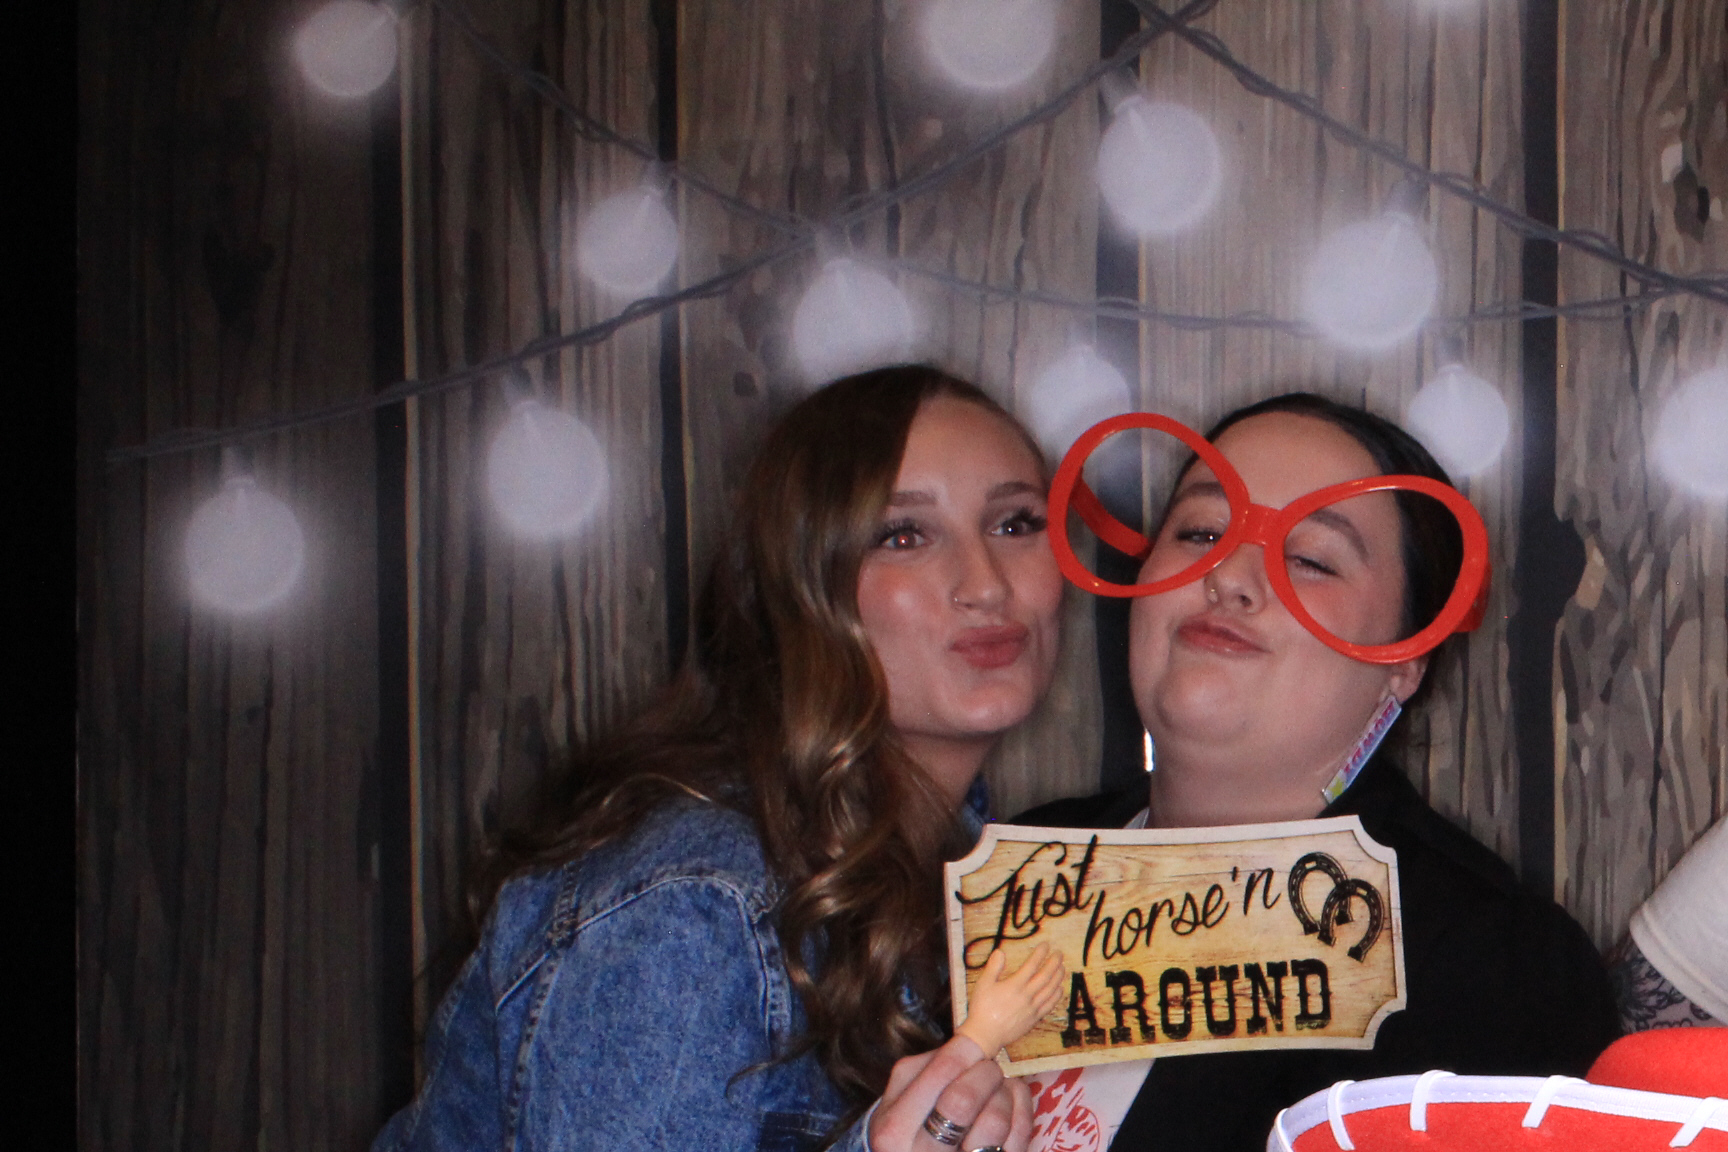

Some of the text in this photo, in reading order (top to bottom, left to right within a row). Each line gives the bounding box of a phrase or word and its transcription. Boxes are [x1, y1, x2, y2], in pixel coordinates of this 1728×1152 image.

[955, 834, 1097, 969] Just
[1083, 867, 1281, 966] horse'n
[1060, 959, 1331, 1048] AROUND
